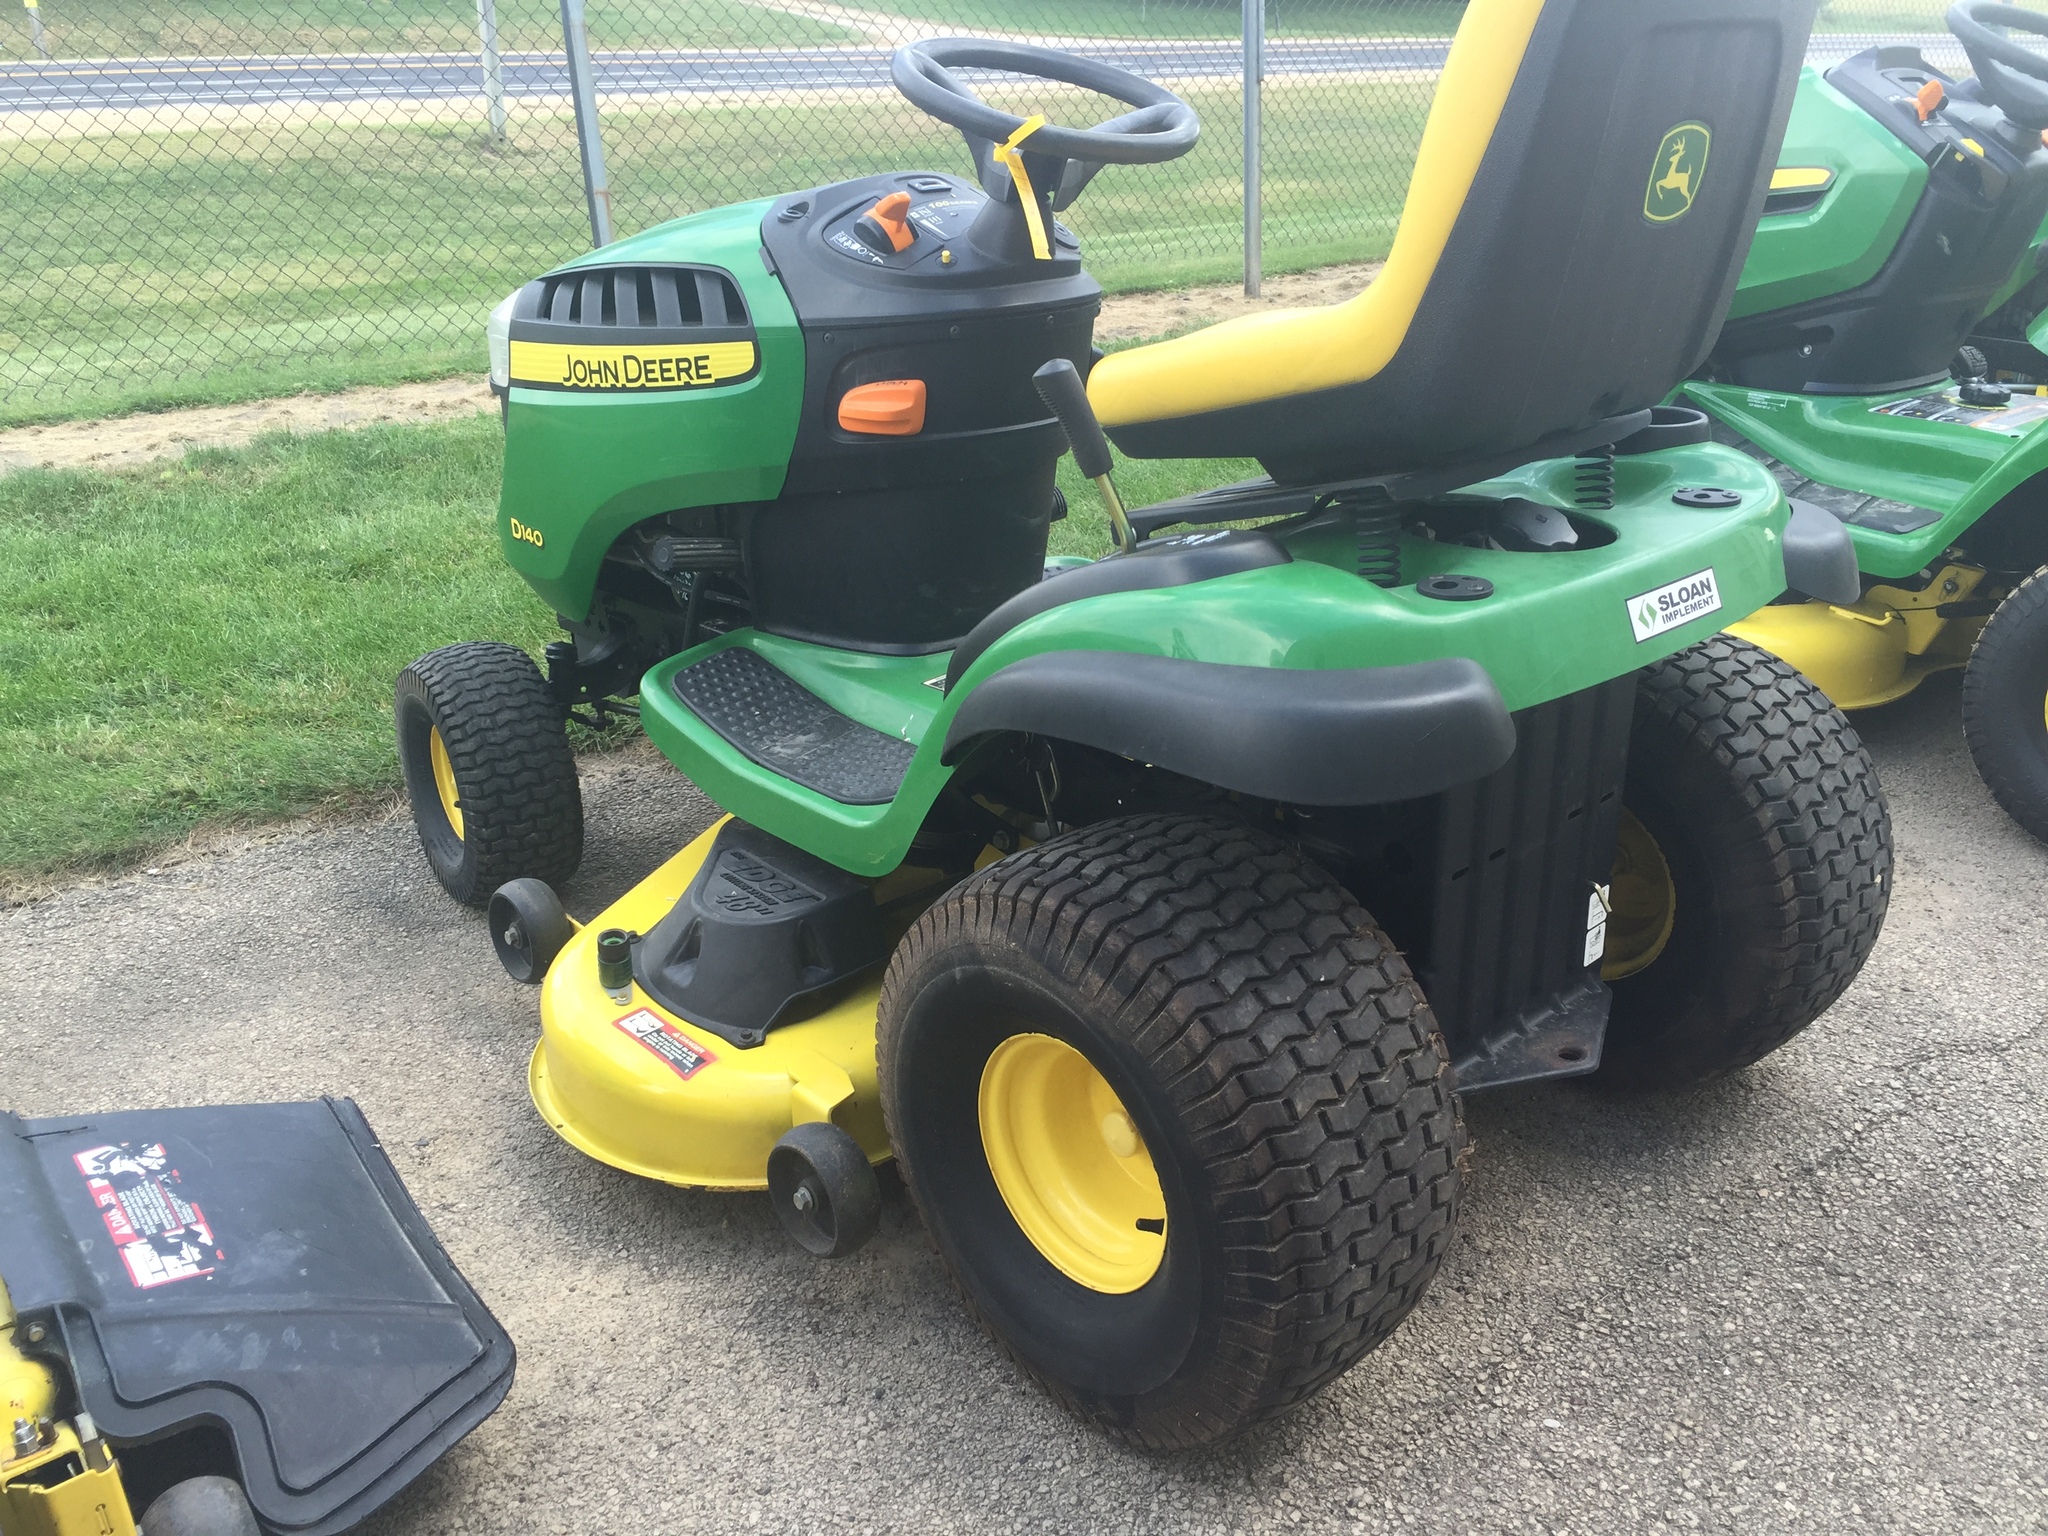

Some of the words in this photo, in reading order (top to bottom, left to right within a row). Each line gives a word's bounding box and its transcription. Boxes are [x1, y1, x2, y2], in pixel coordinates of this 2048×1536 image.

[929, 200, 950, 208] 100
[562, 354, 619, 384] JOHN
[623, 354, 712, 384] DEERE
[510, 517, 543, 547] D140
[1657, 577, 1712, 612] SLOAN
[1661, 595, 1714, 624] IMPLEMENT
[679, 1035, 706, 1054] DANGER
[99, 1192, 126, 1228] DANER
